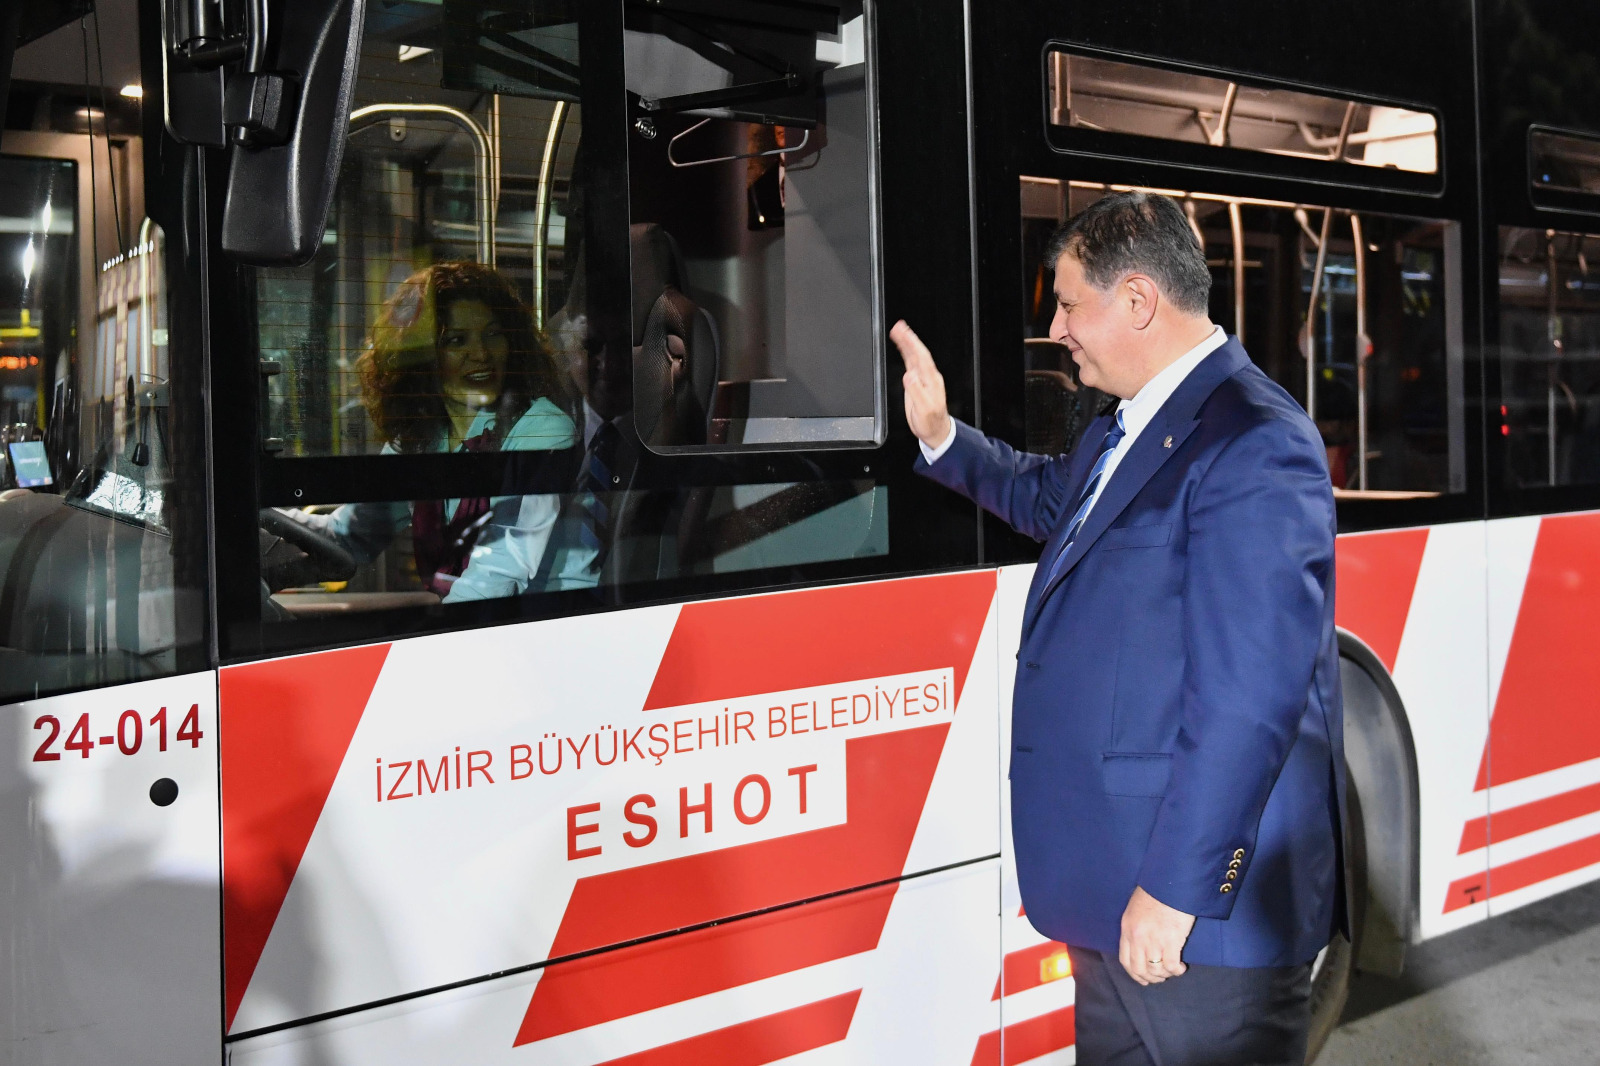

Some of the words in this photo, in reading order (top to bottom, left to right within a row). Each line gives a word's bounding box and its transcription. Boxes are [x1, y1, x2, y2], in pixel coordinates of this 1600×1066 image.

[33, 703, 204, 762] 24-014
[375, 745, 495, 803] İZMİR
[510, 706, 756, 781] BÜYÜKŞEHİR
[768, 675, 948, 739] BELEDİYESİ
[566, 763, 818, 862] ESHOT
